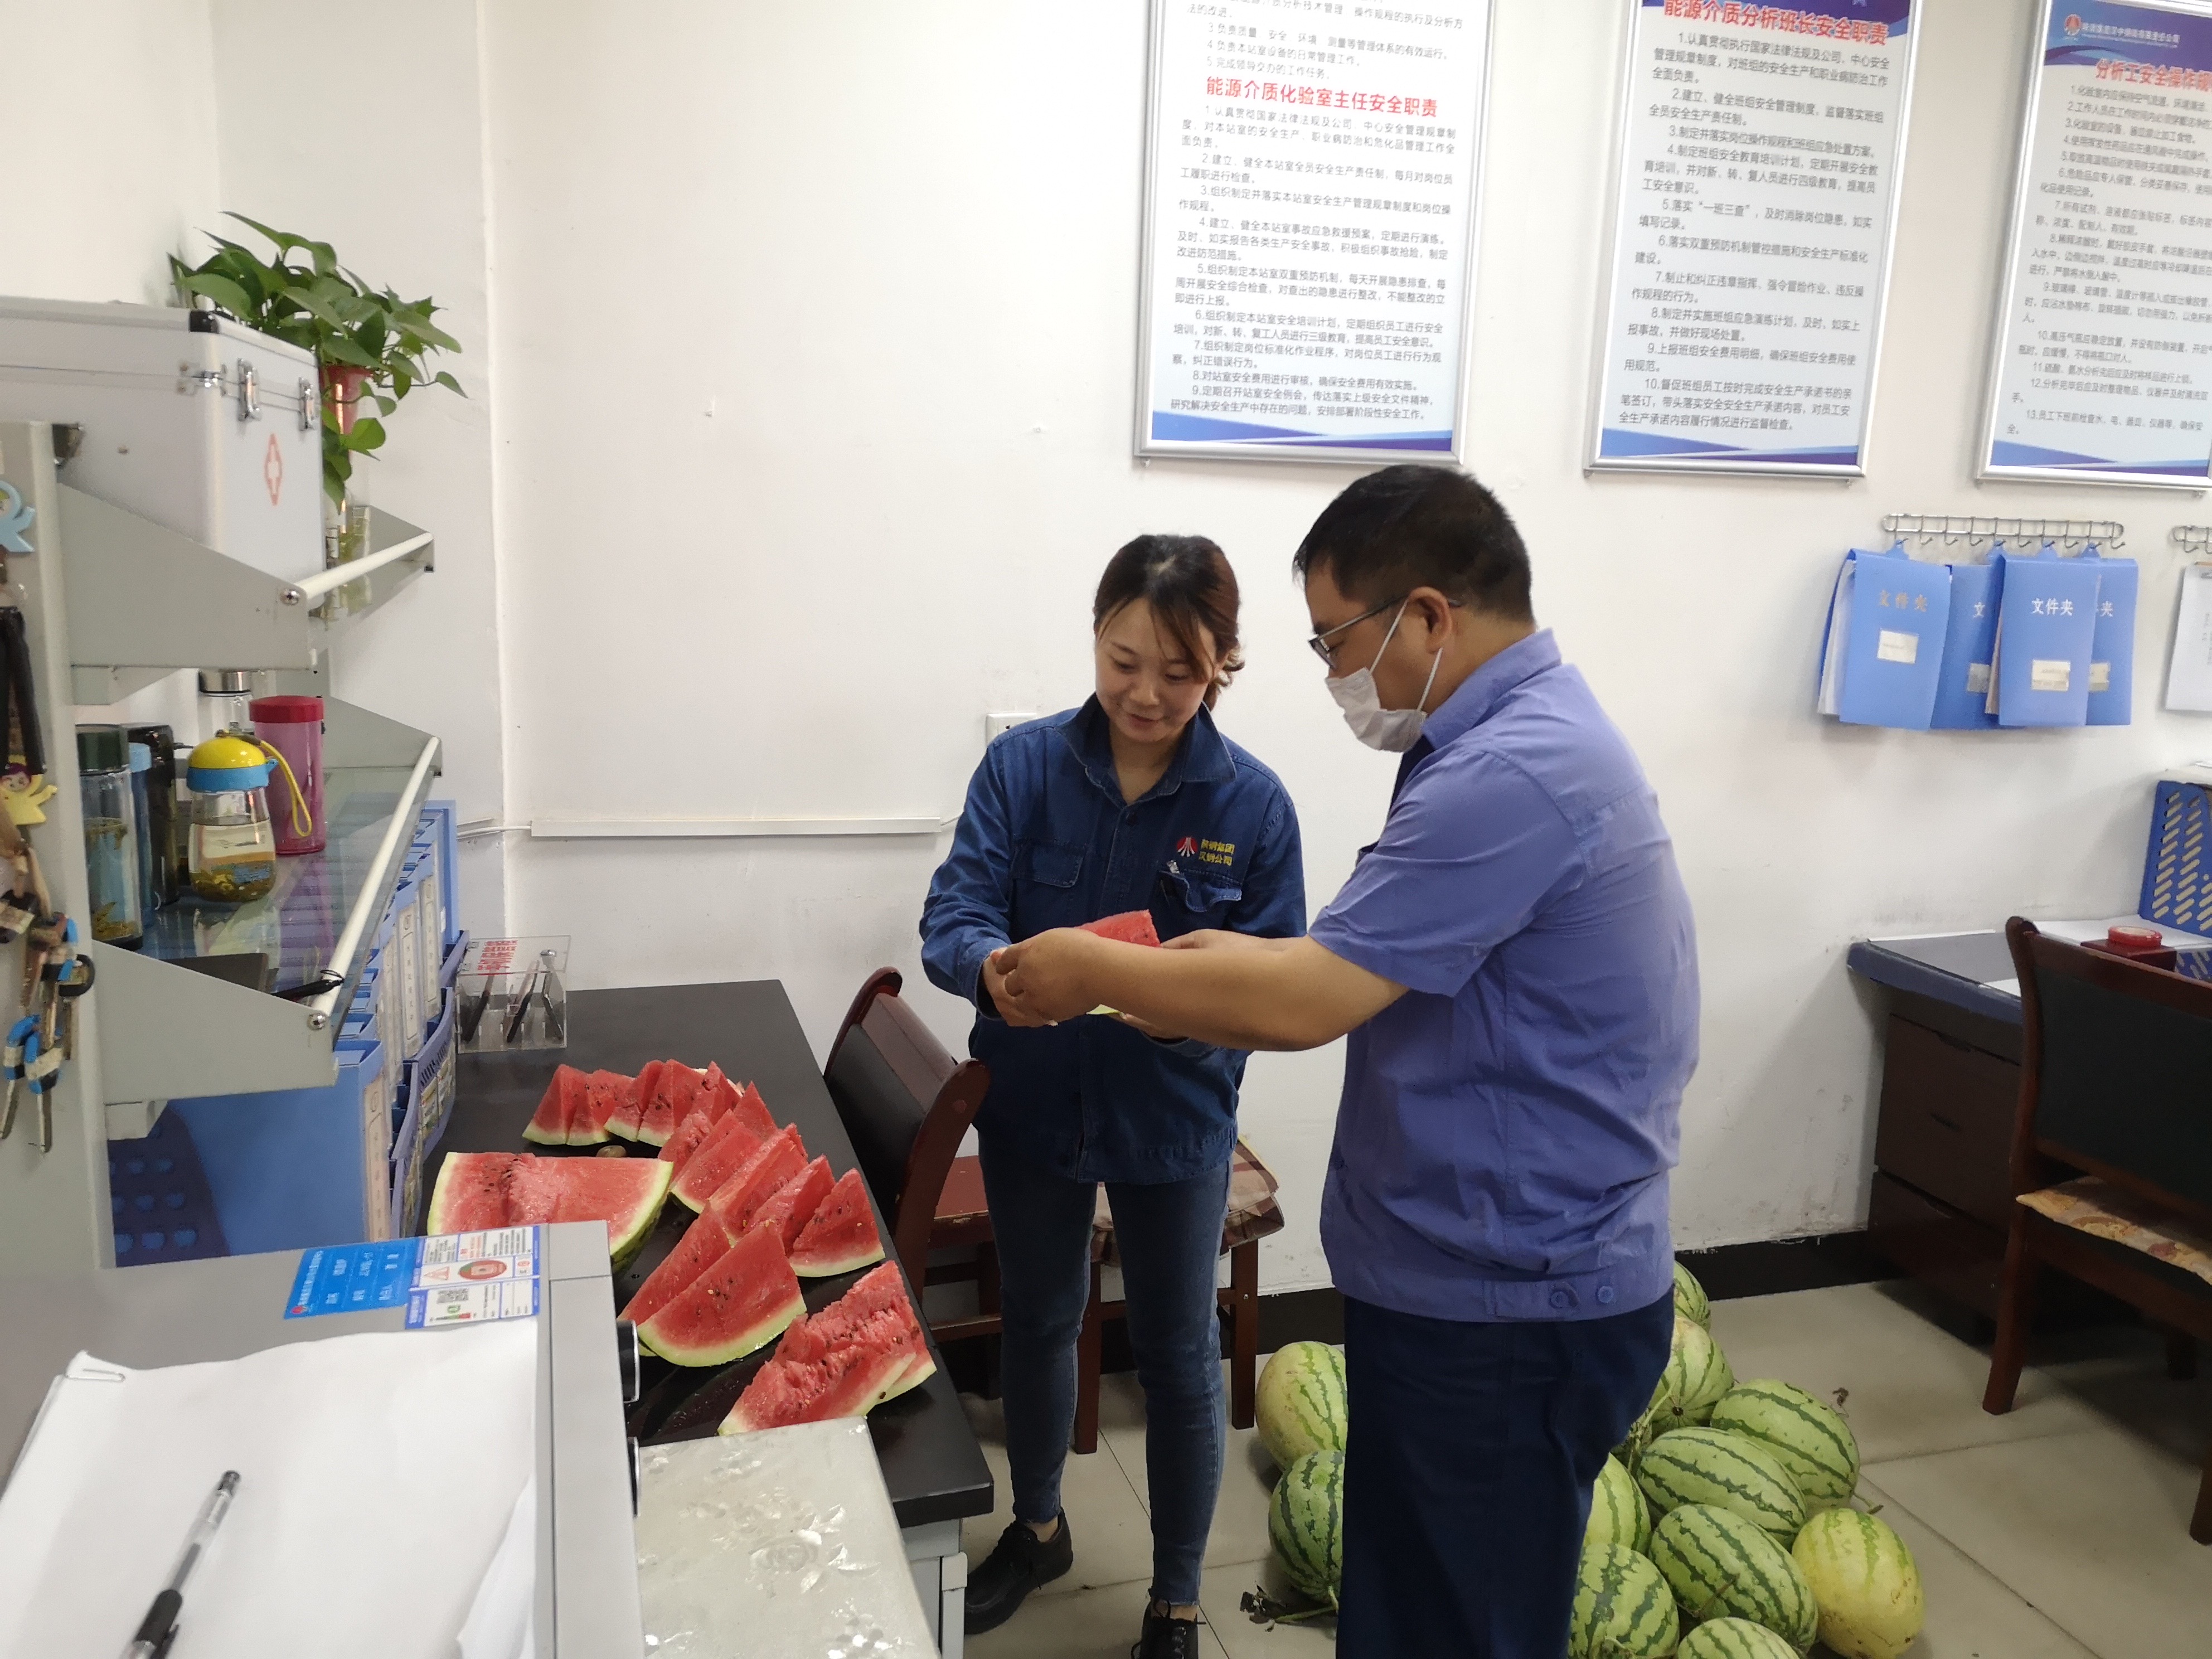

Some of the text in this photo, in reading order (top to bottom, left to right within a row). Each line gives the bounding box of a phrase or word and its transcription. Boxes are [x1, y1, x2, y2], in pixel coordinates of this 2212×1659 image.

[1664, 0, 1888, 45] 能源介质分析班长安全职责
[1207, 76, 1437, 117] 能源介质化验室主任安全职责
[2007, 424, 2019, 434] 全。
[1879, 589, 1928, 613] 文件夹
[2031, 598, 2073, 617] 文件夹
